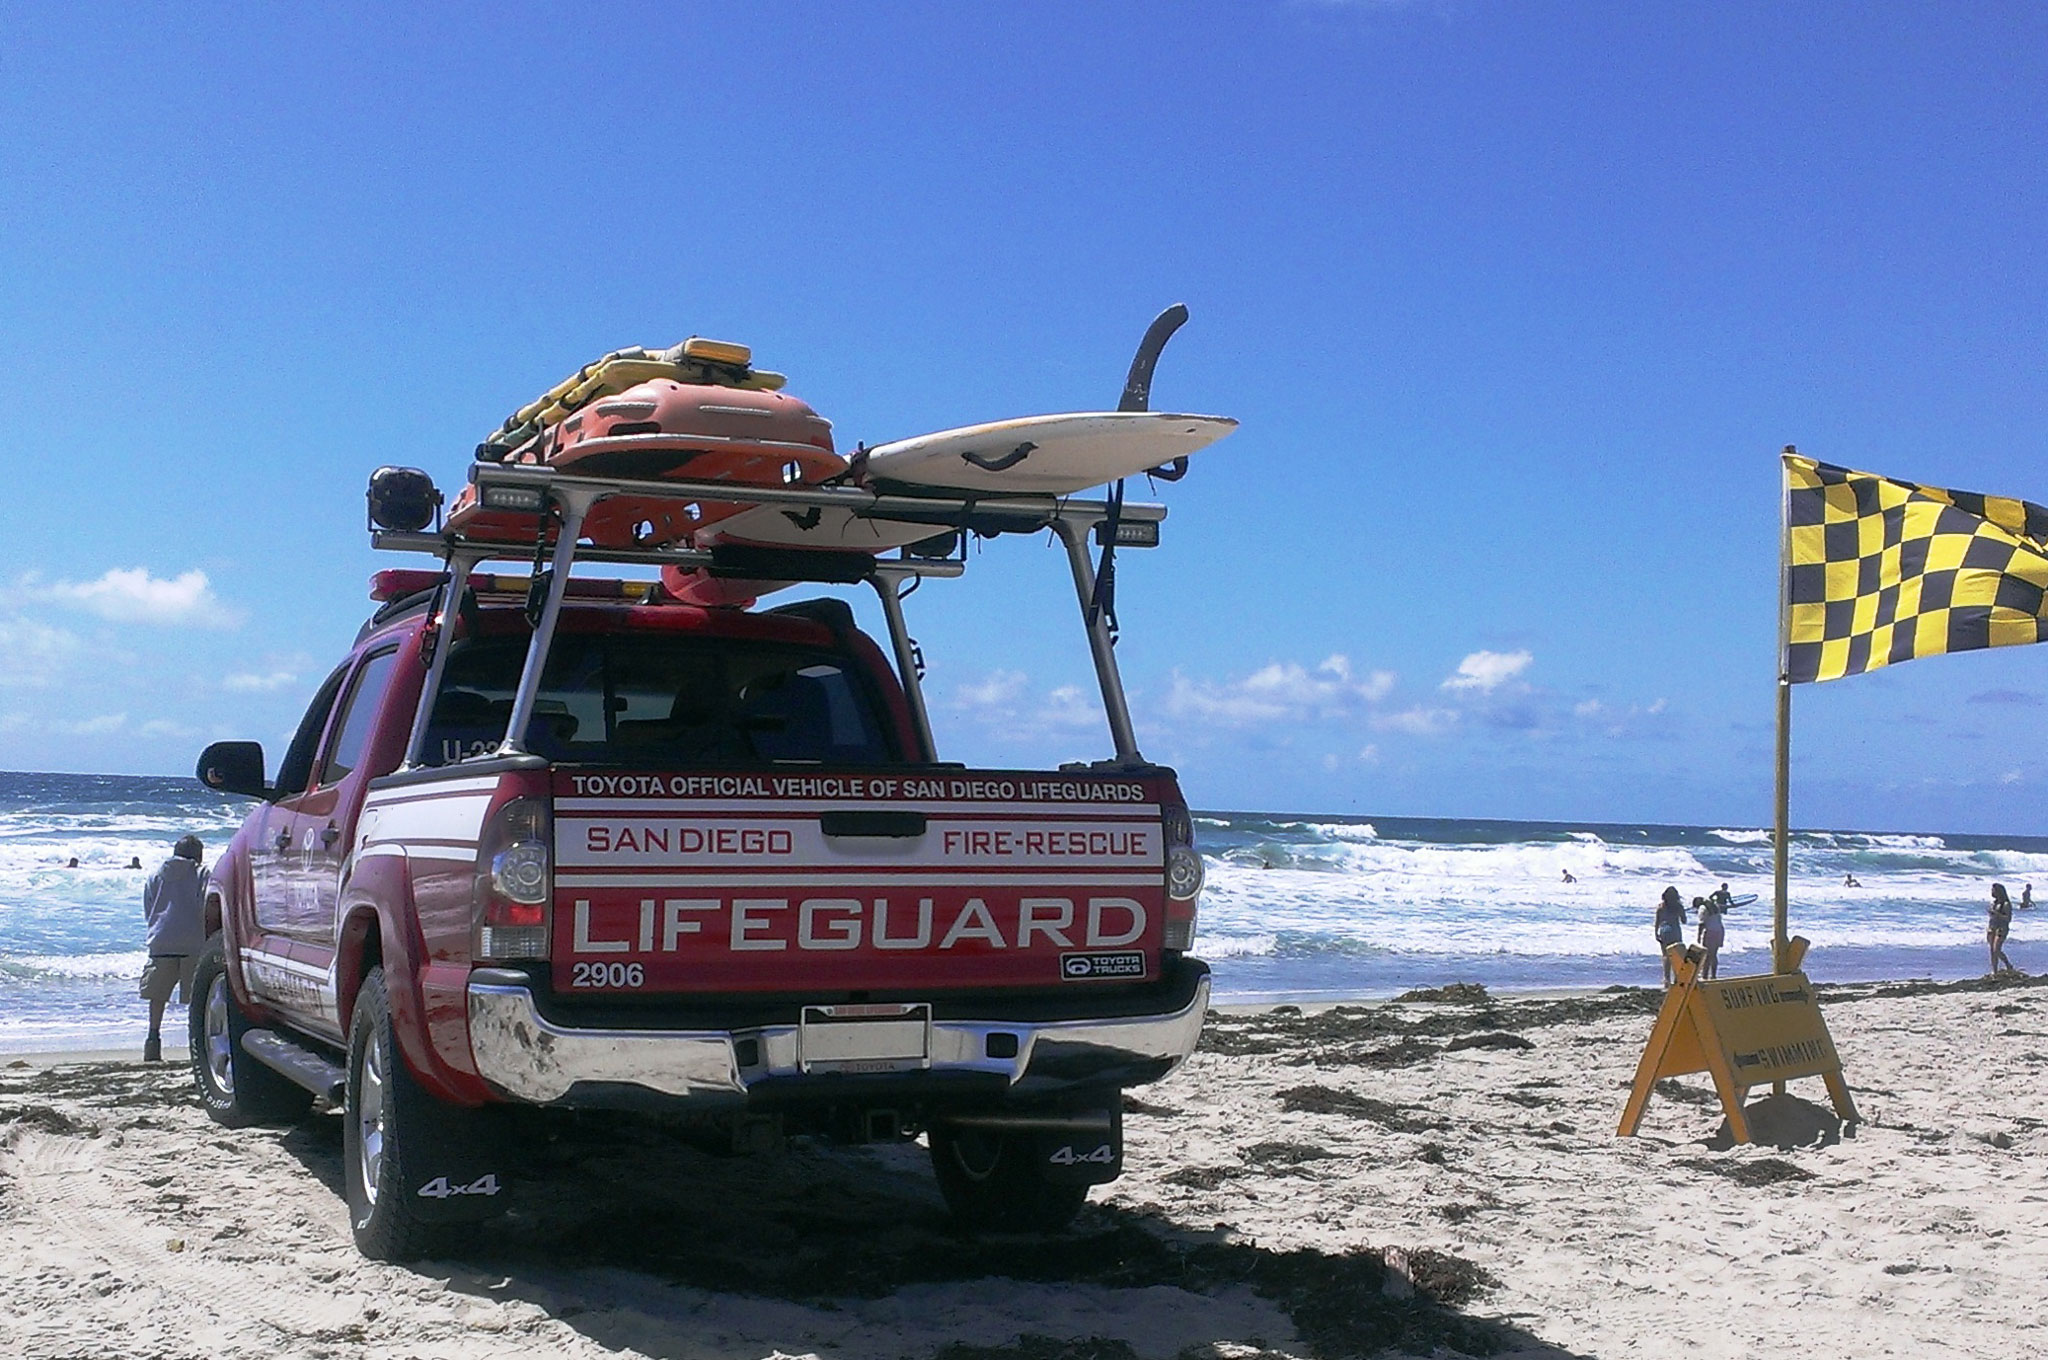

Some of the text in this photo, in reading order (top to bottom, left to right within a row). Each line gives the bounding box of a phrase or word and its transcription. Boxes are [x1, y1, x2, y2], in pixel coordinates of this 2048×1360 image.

[572, 776, 1144, 801] TOYOTA OFFICIAL VEHICLE OF SAN DIEGO LIFEGUARDS
[587, 827, 792, 854] SAN DIEGO
[943, 831, 1147, 856] FIRE-RESCUE
[573, 897, 1147, 953] LIFEGUARD
[1092, 955, 1139, 965] TOYOTA
[1093, 964, 1141, 974] TRUCKS
[572, 963, 644, 987] 2906
[1721, 983, 1780, 1009] SURFING
[856, 1062, 895, 1072] TOYOTA
[1049, 1144, 1115, 1166] 4x4
[417, 1173, 502, 1198] 4x4
